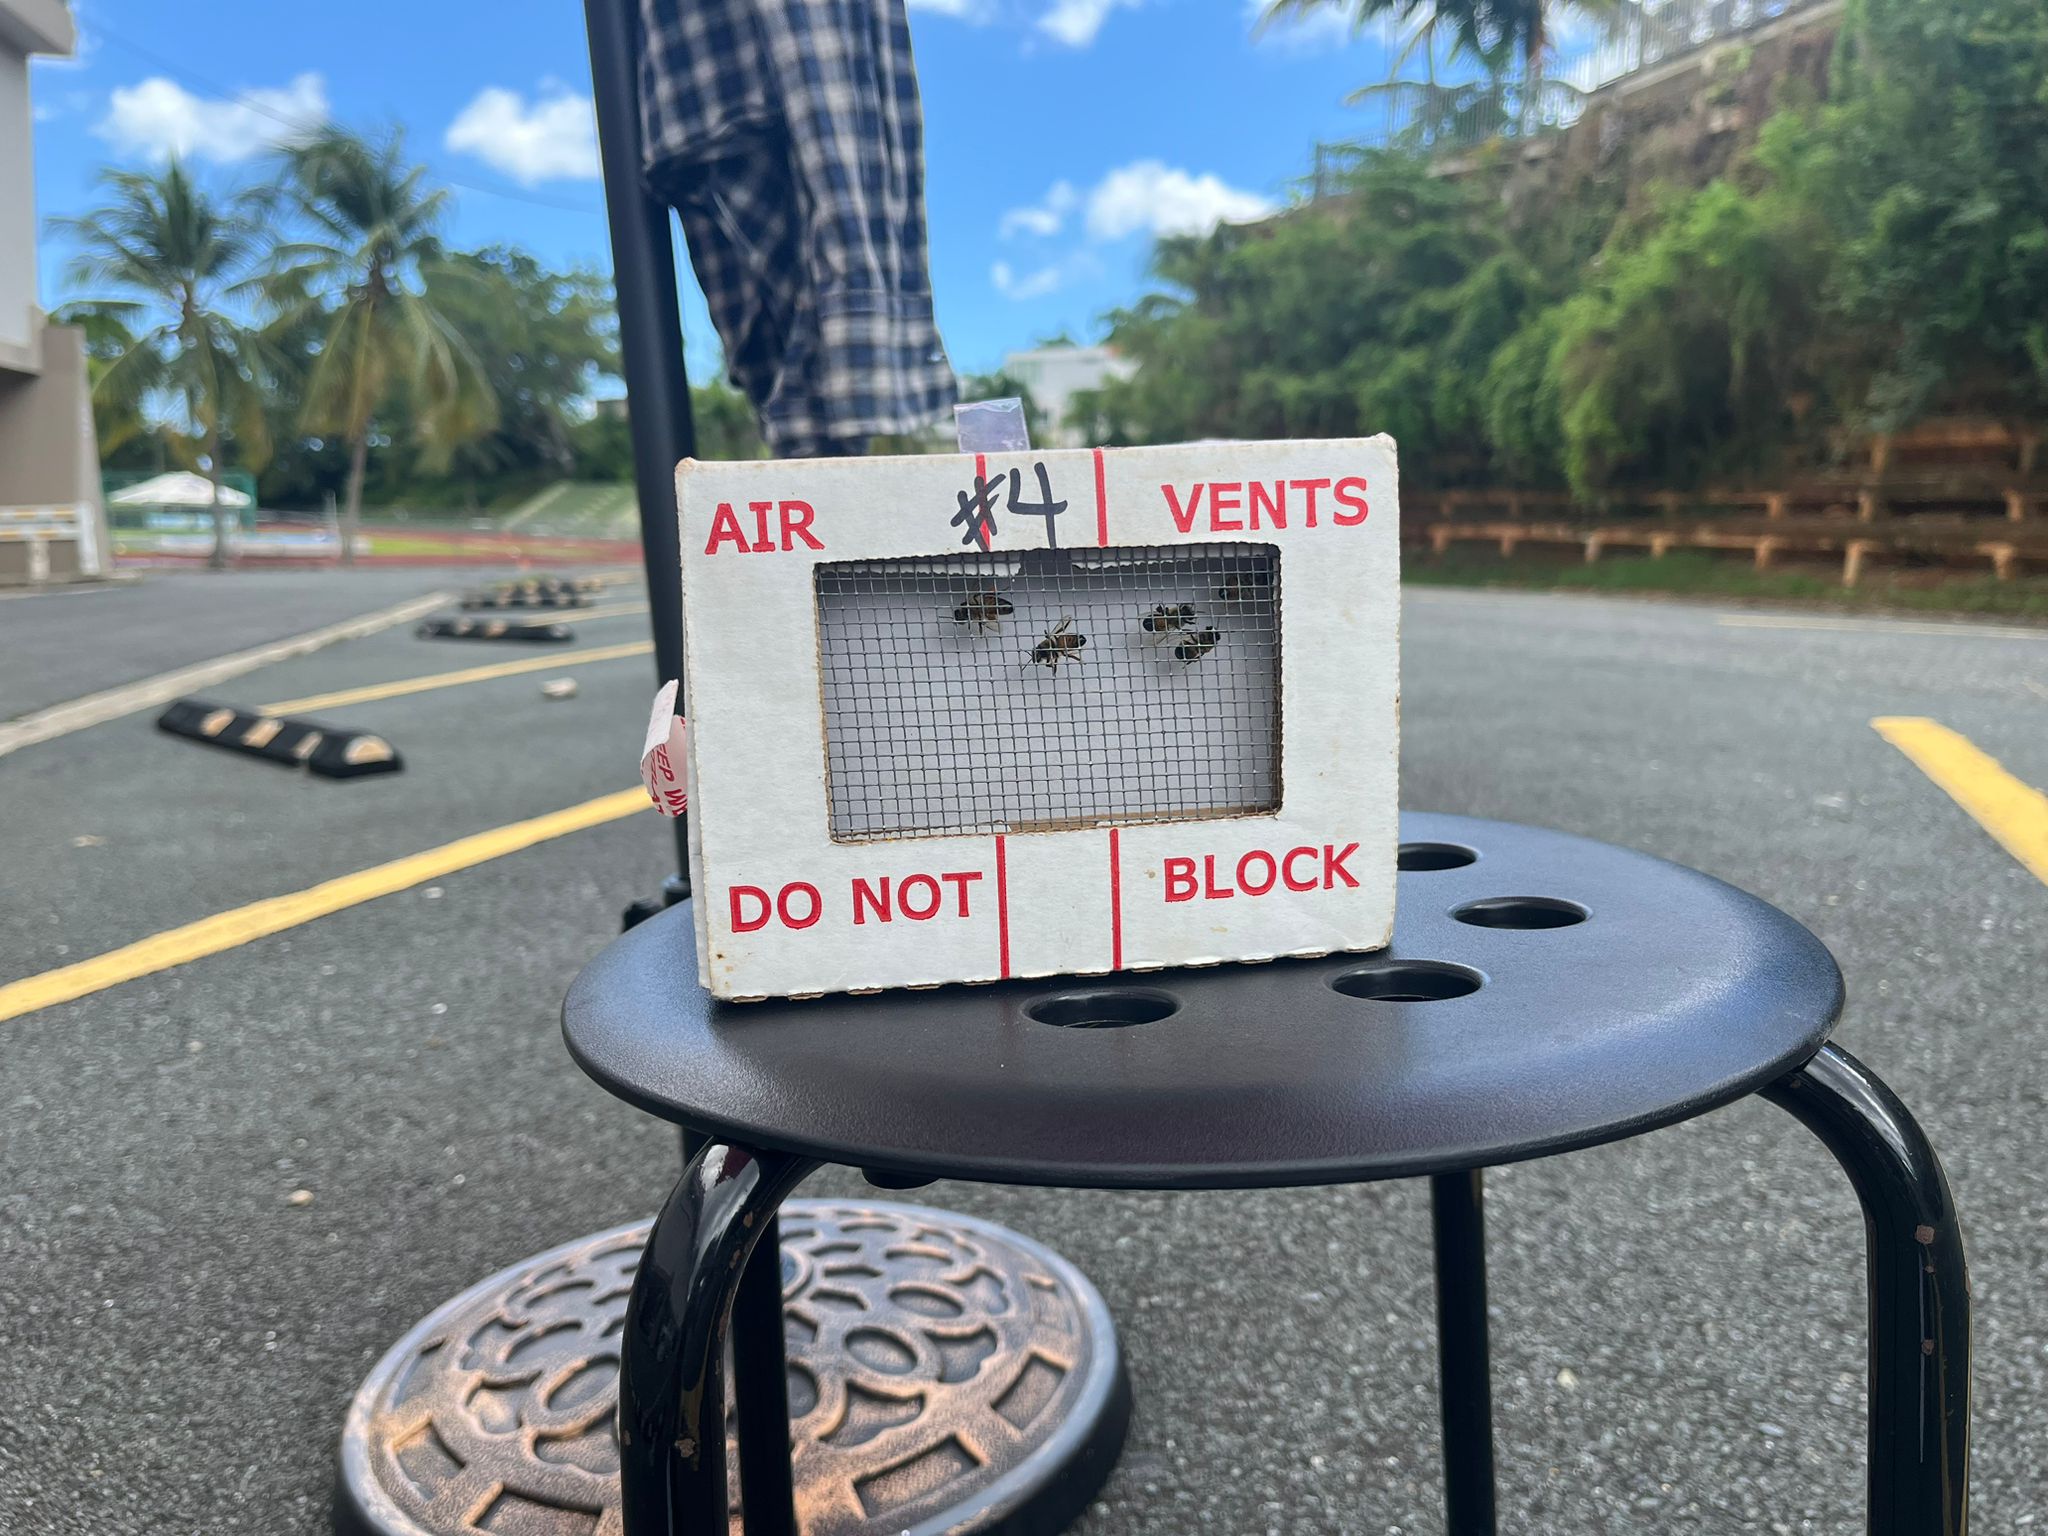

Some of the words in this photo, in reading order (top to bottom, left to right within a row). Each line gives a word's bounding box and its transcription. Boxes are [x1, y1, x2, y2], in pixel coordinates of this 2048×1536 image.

[704, 500, 825, 555] AIR
[1161, 477, 1369, 533] VENTS
[951, 461, 1068, 551] #4
[729, 881, 823, 934] DO
[851, 871, 983, 925] NOT
[1164, 843, 1360, 903] BLOCK
